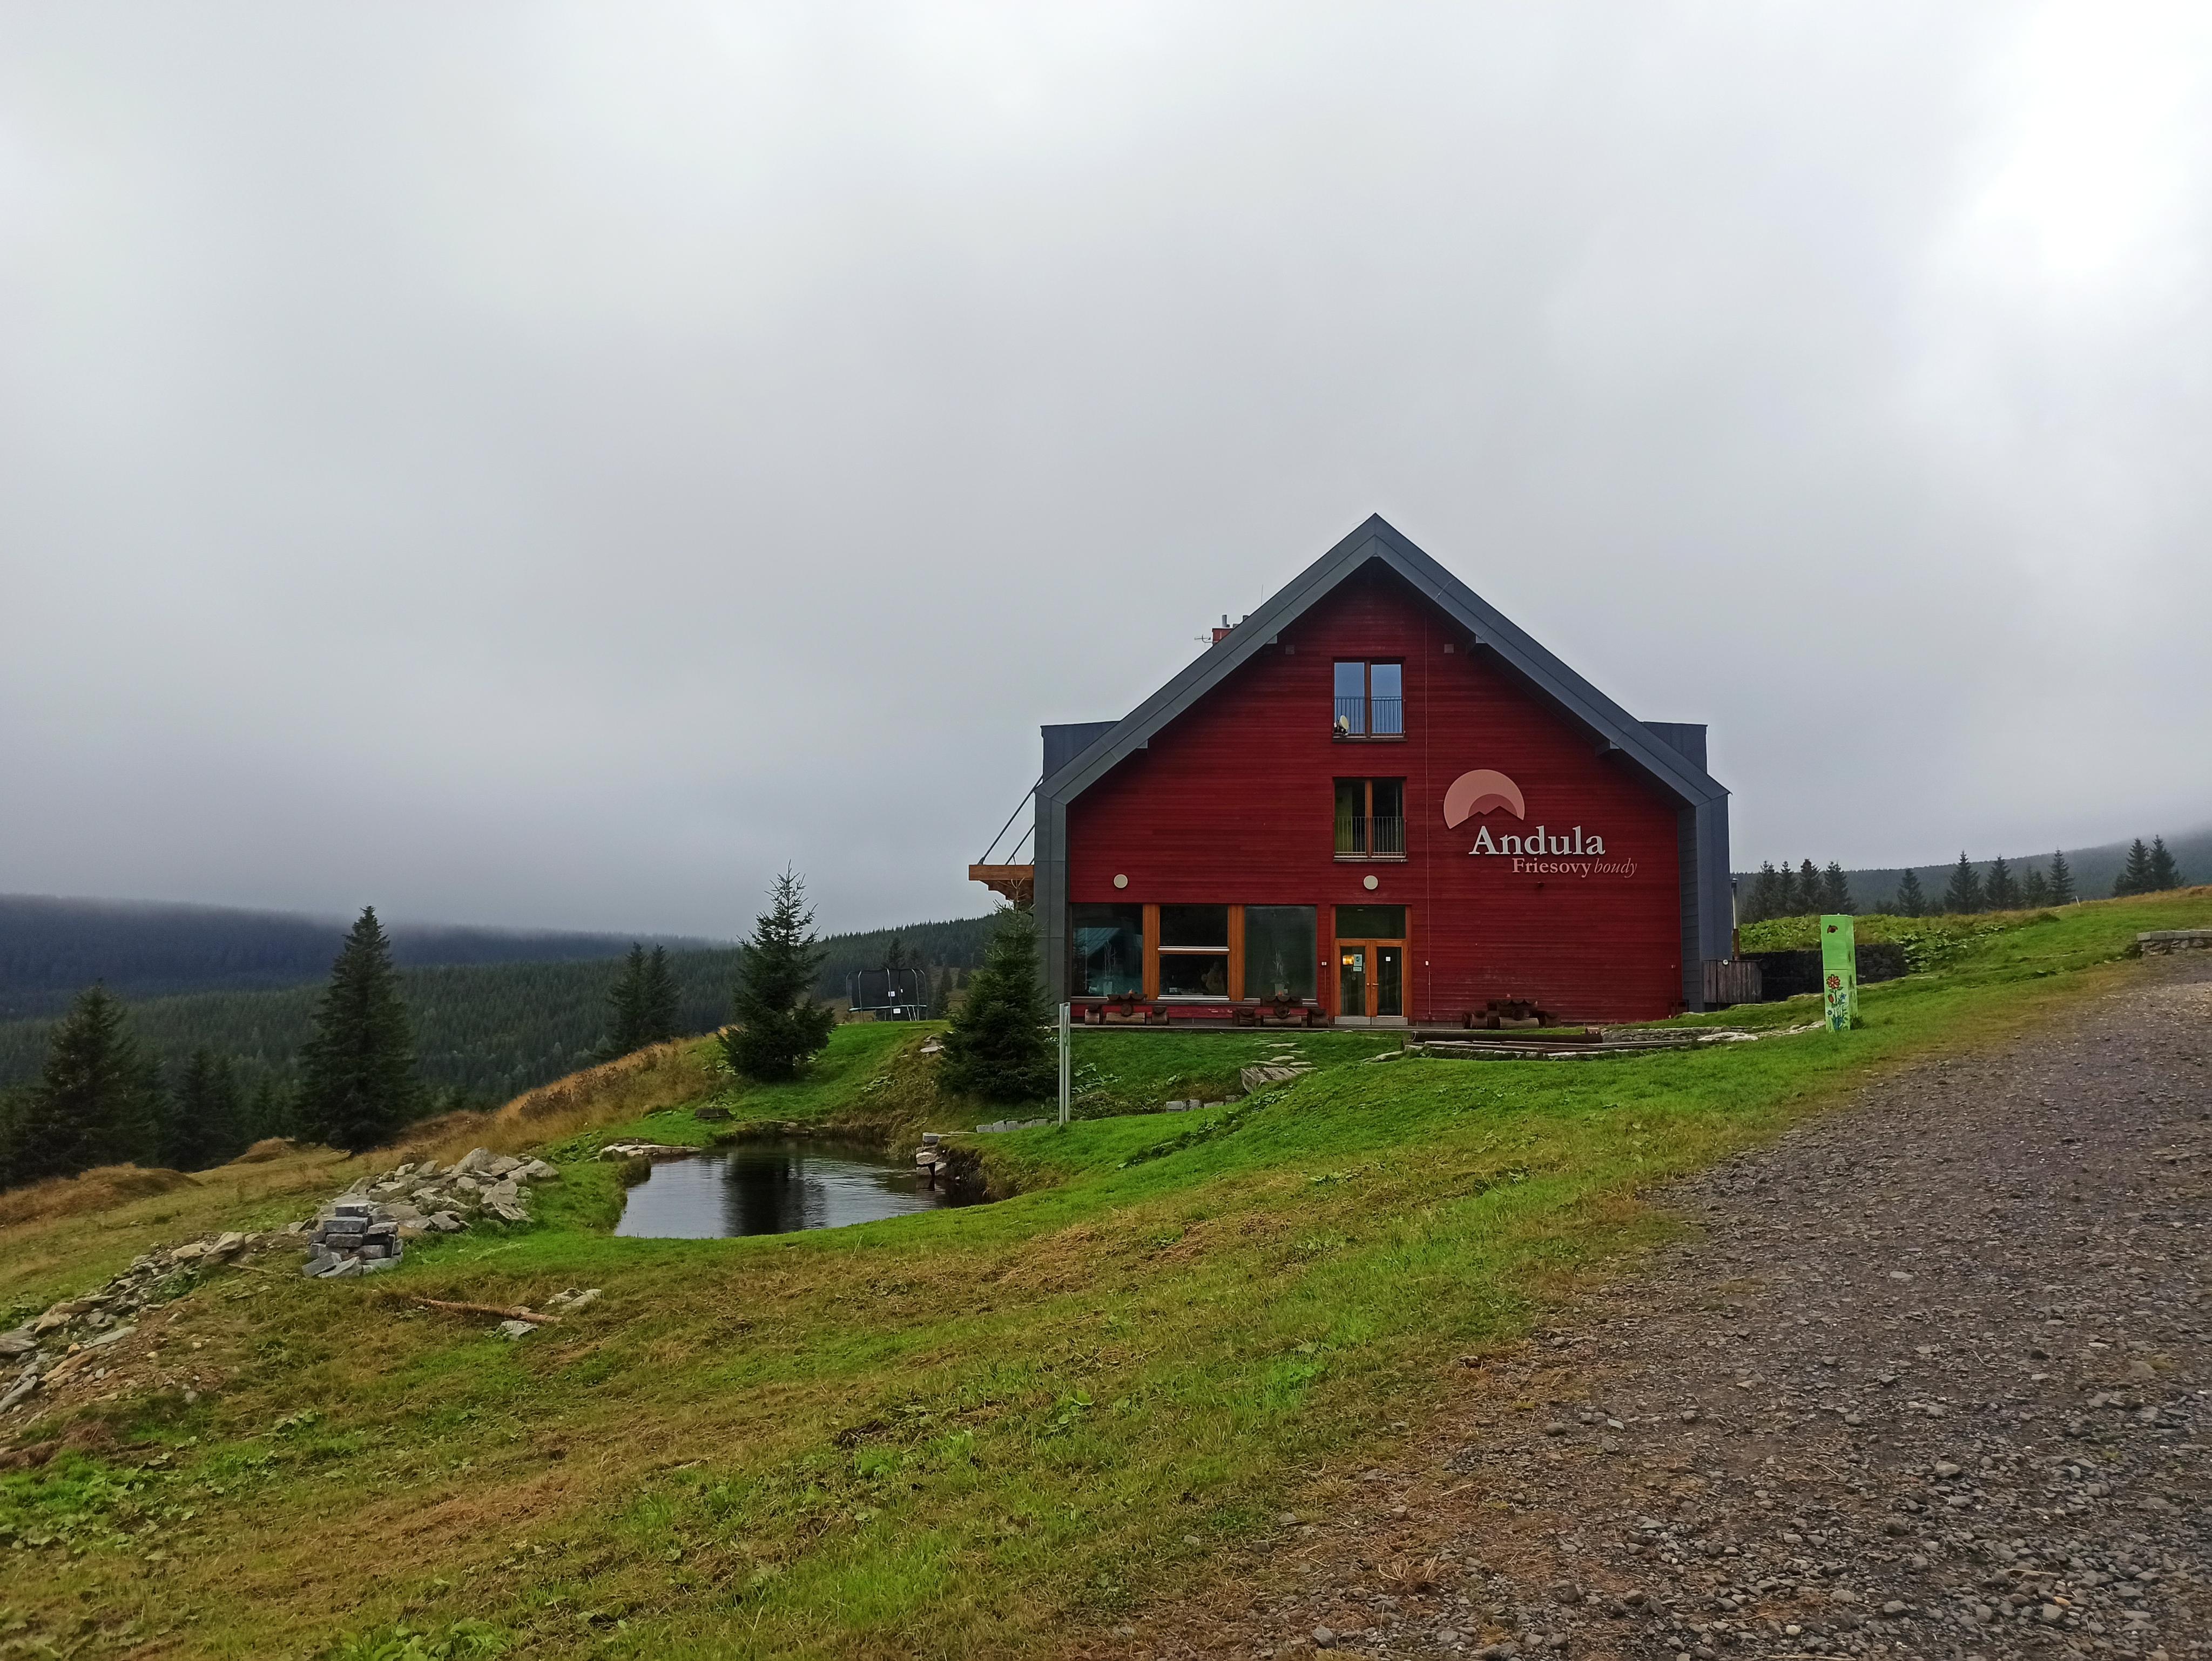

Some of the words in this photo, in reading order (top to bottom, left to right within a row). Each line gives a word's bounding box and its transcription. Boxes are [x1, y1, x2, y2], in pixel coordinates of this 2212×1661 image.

[1468, 825, 1606, 855] Andula
[1512, 857, 1591, 878] Friesovy
[1594, 858, 1637, 878] boudy
